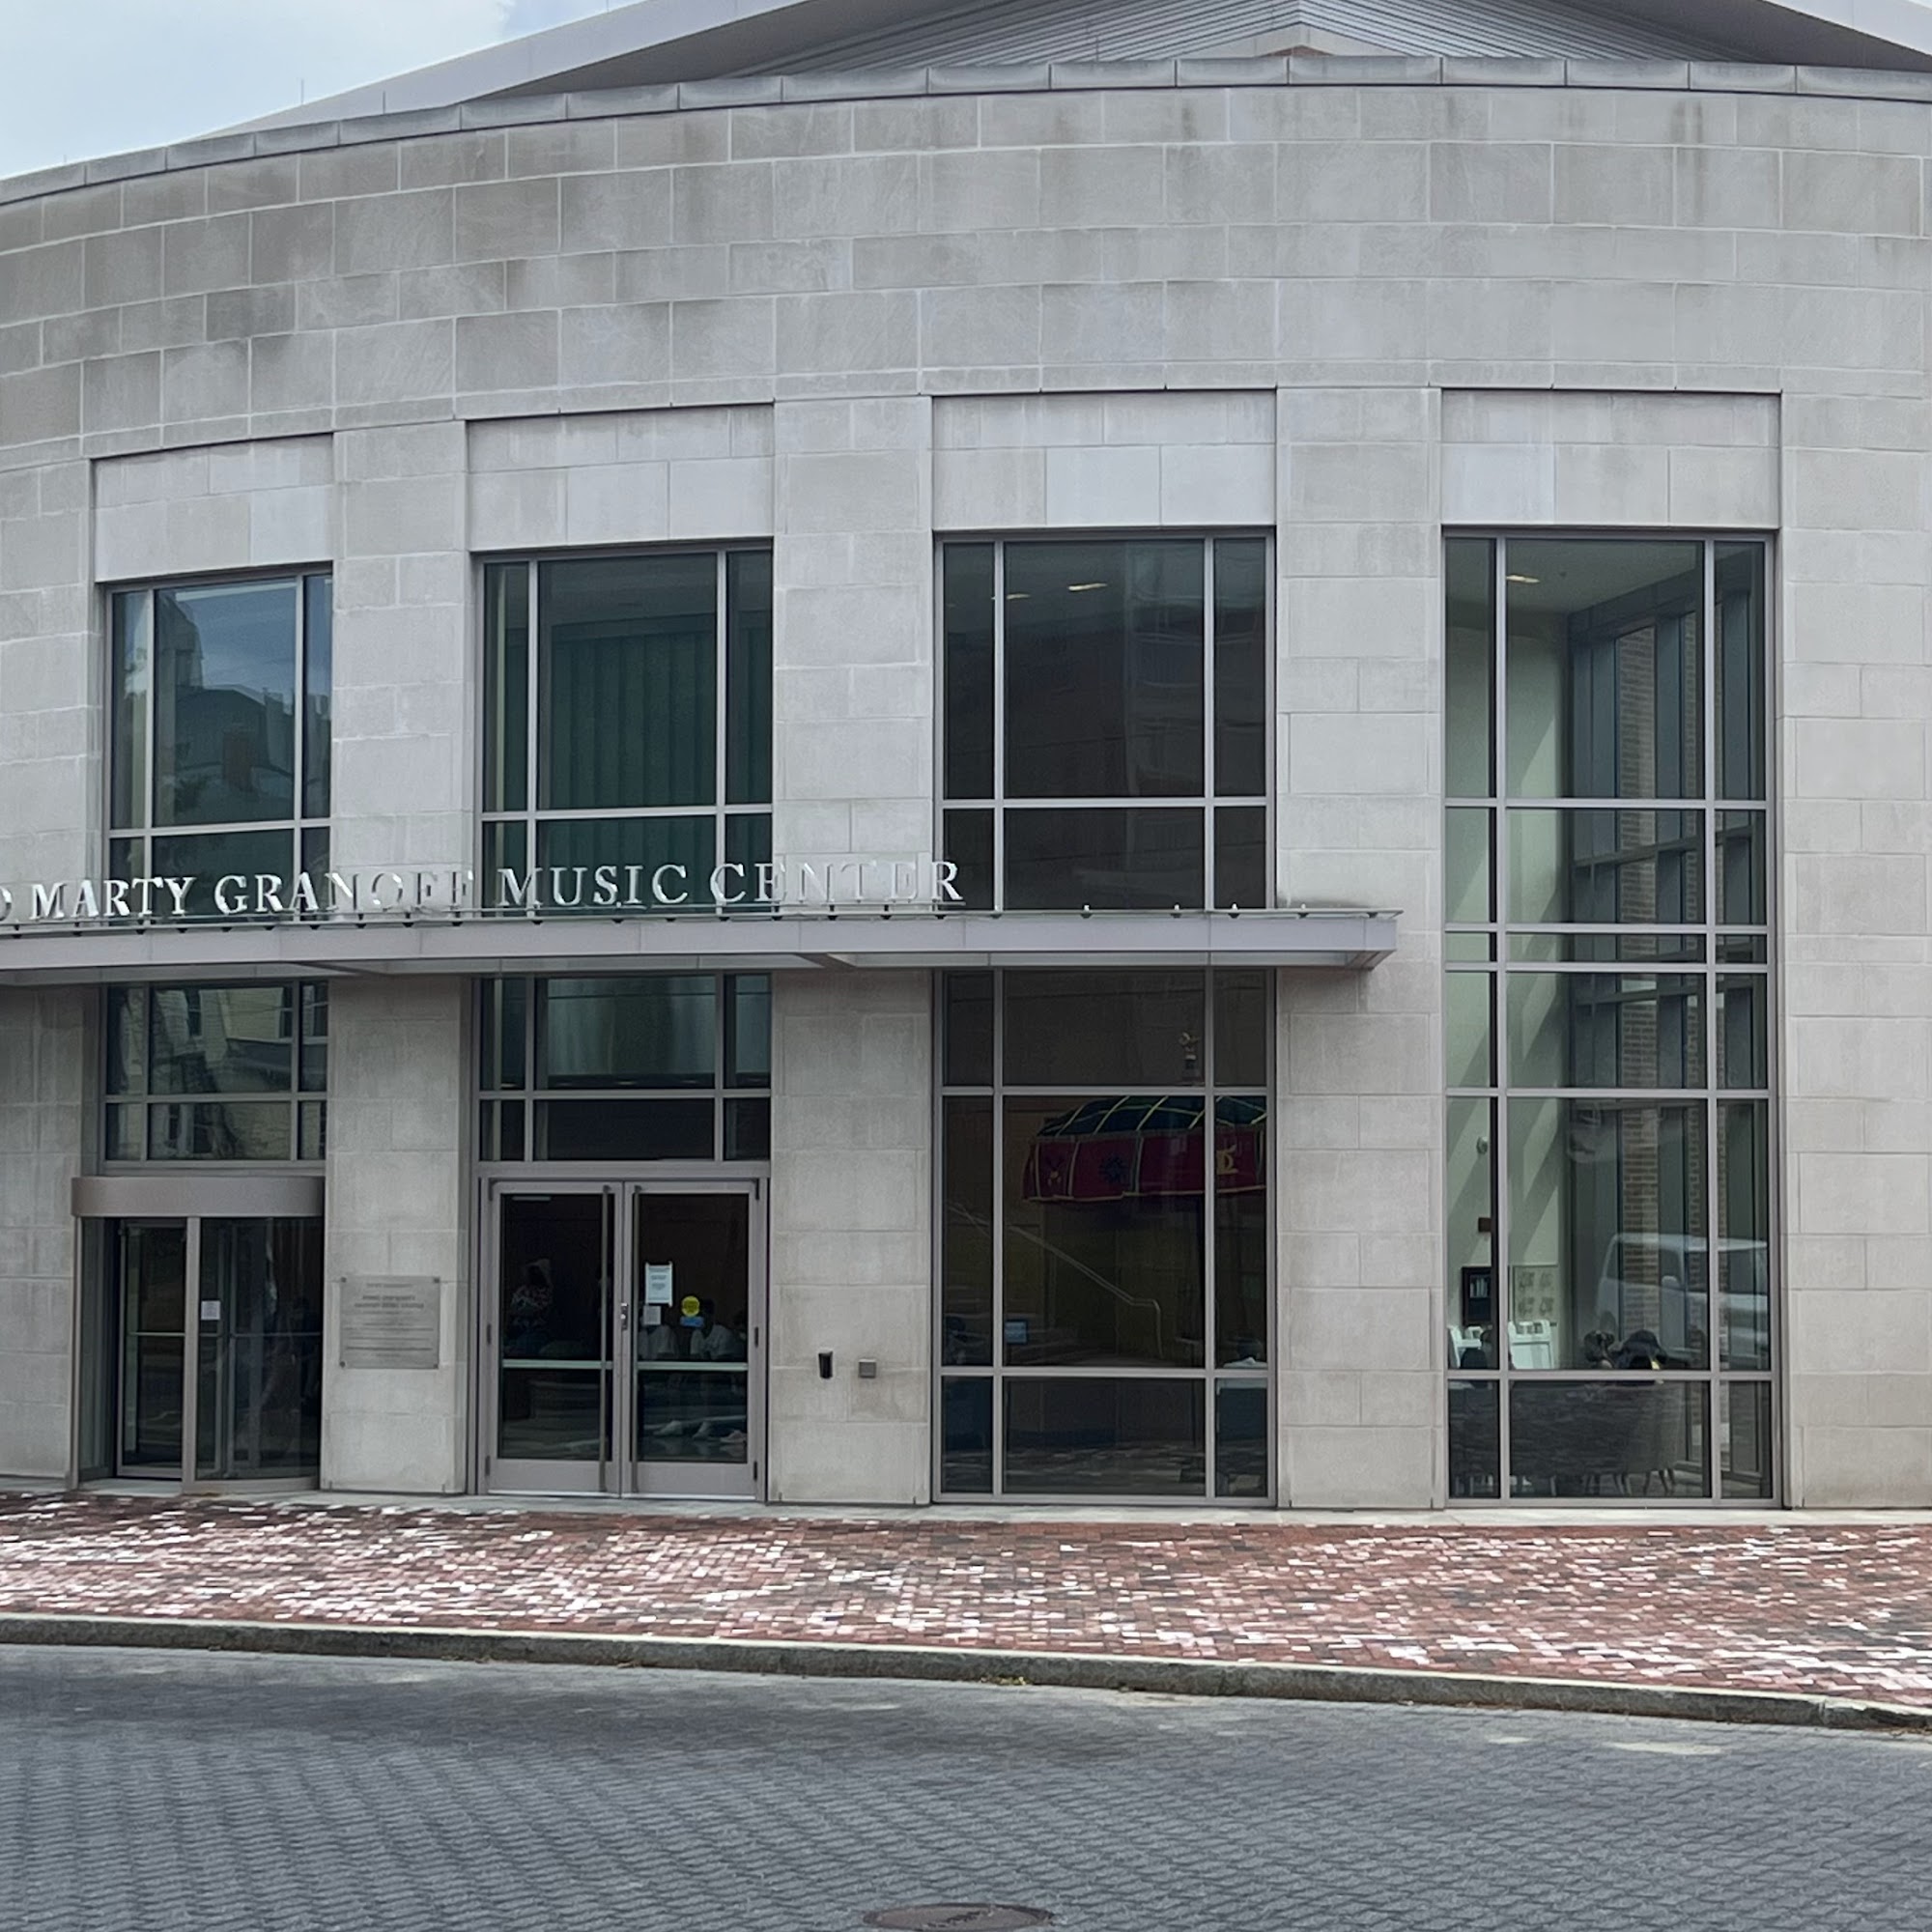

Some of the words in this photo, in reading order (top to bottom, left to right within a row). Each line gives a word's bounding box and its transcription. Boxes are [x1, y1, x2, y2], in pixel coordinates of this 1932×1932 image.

[30, 876, 197, 920] MARTY
[213, 870, 474, 914] GRANOFF
[497, 865, 689, 906] MUSIC
[710, 860, 963, 903] CENTER
